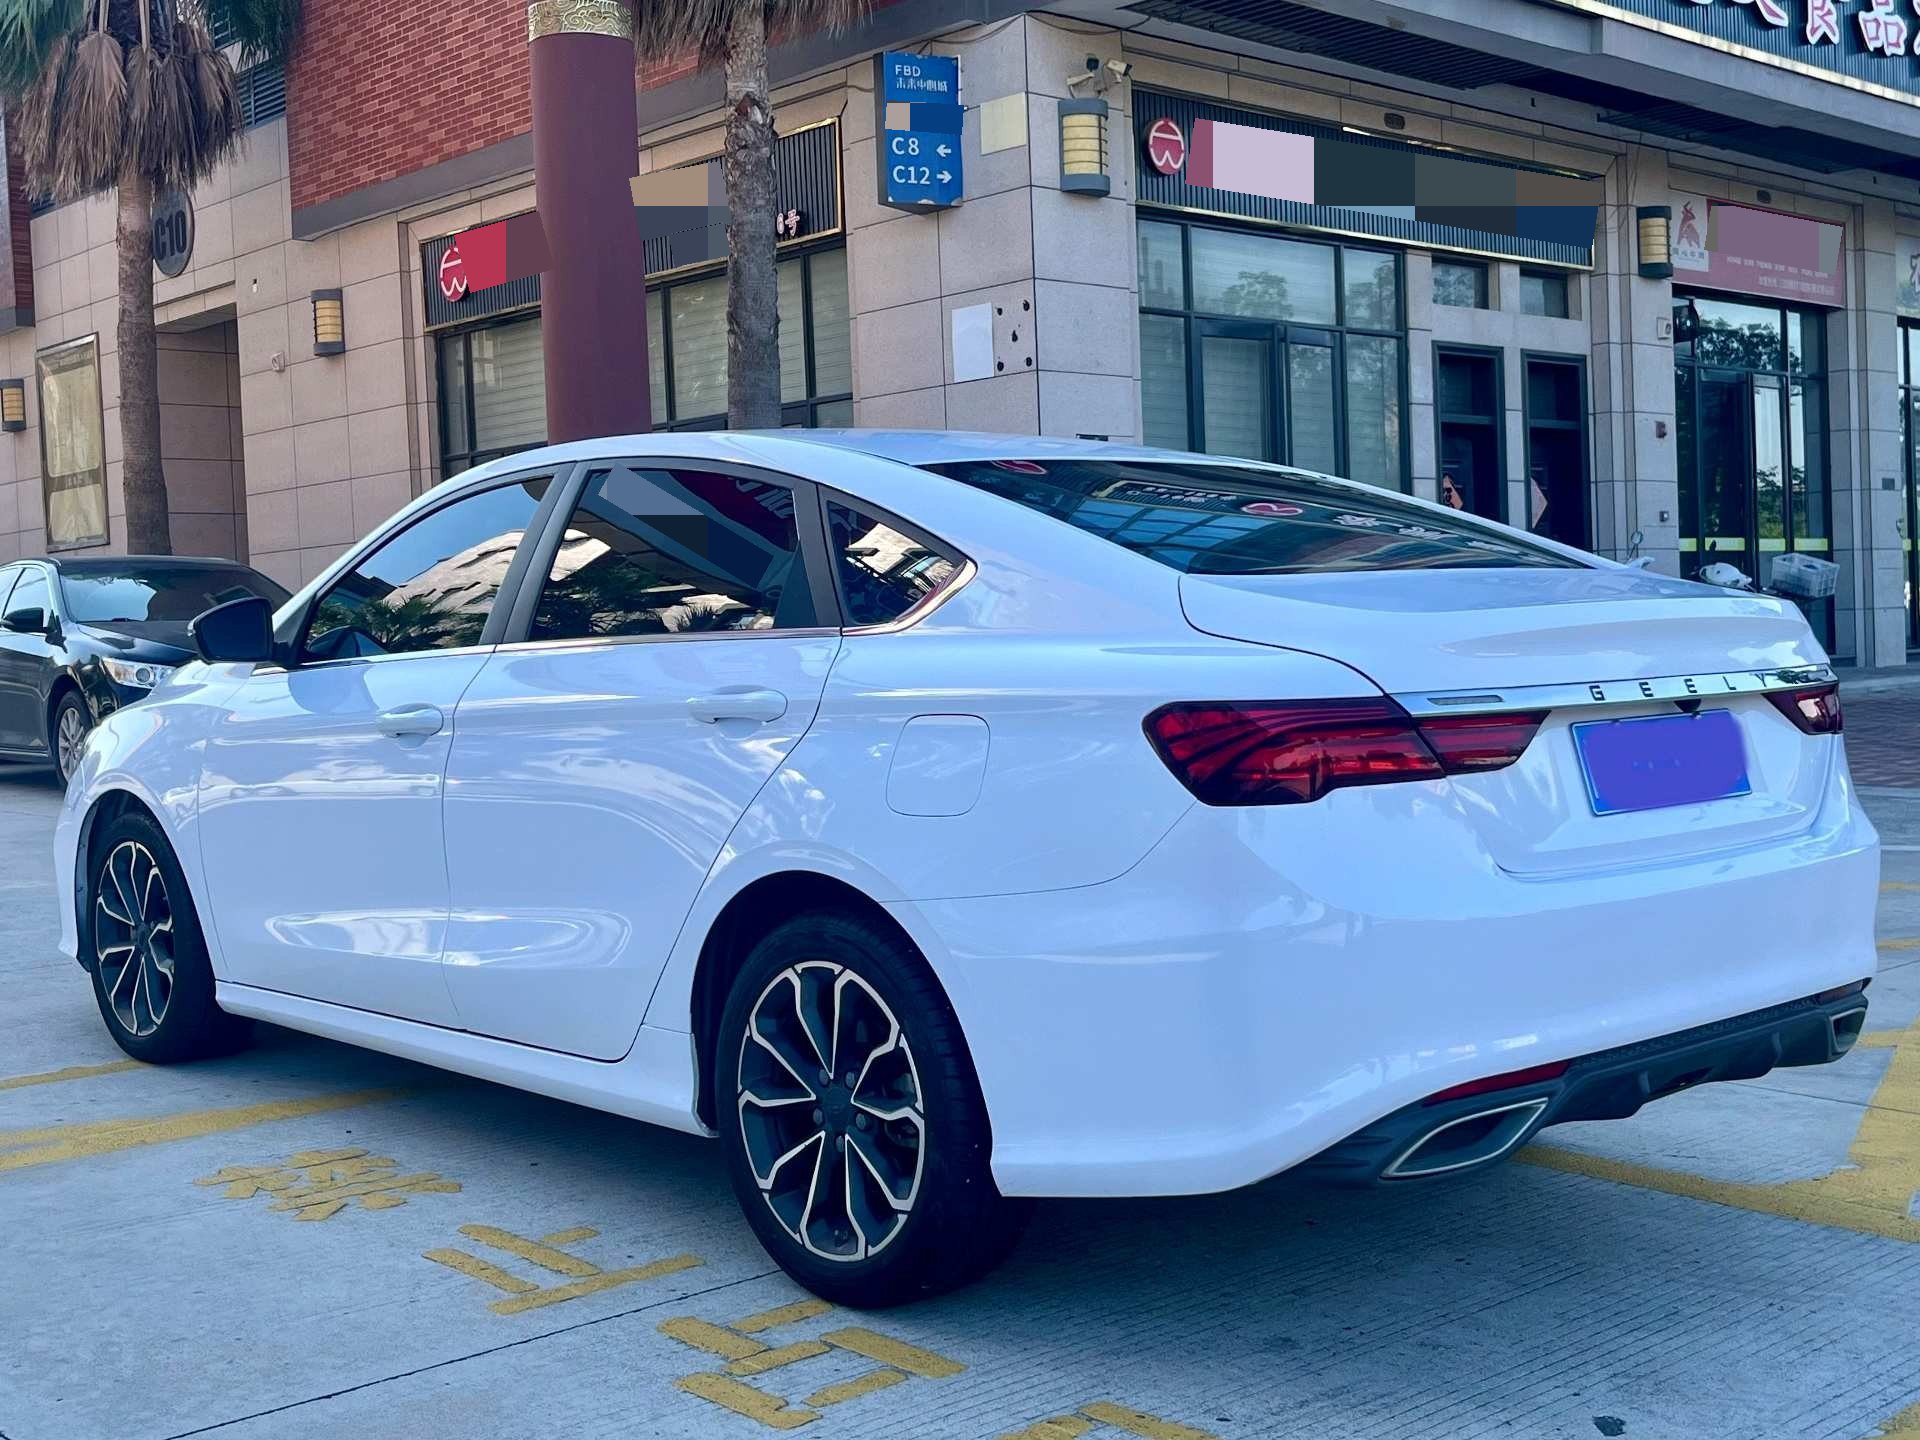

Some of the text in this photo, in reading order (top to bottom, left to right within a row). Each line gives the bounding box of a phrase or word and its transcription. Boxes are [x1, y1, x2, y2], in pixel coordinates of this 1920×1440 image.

[895, 64, 921, 77] FBD
[891, 136, 920, 156] C8
[892, 165, 931, 185] C12
[154, 209, 187, 261] C10
[1588, 671, 1769, 702] GEELY
